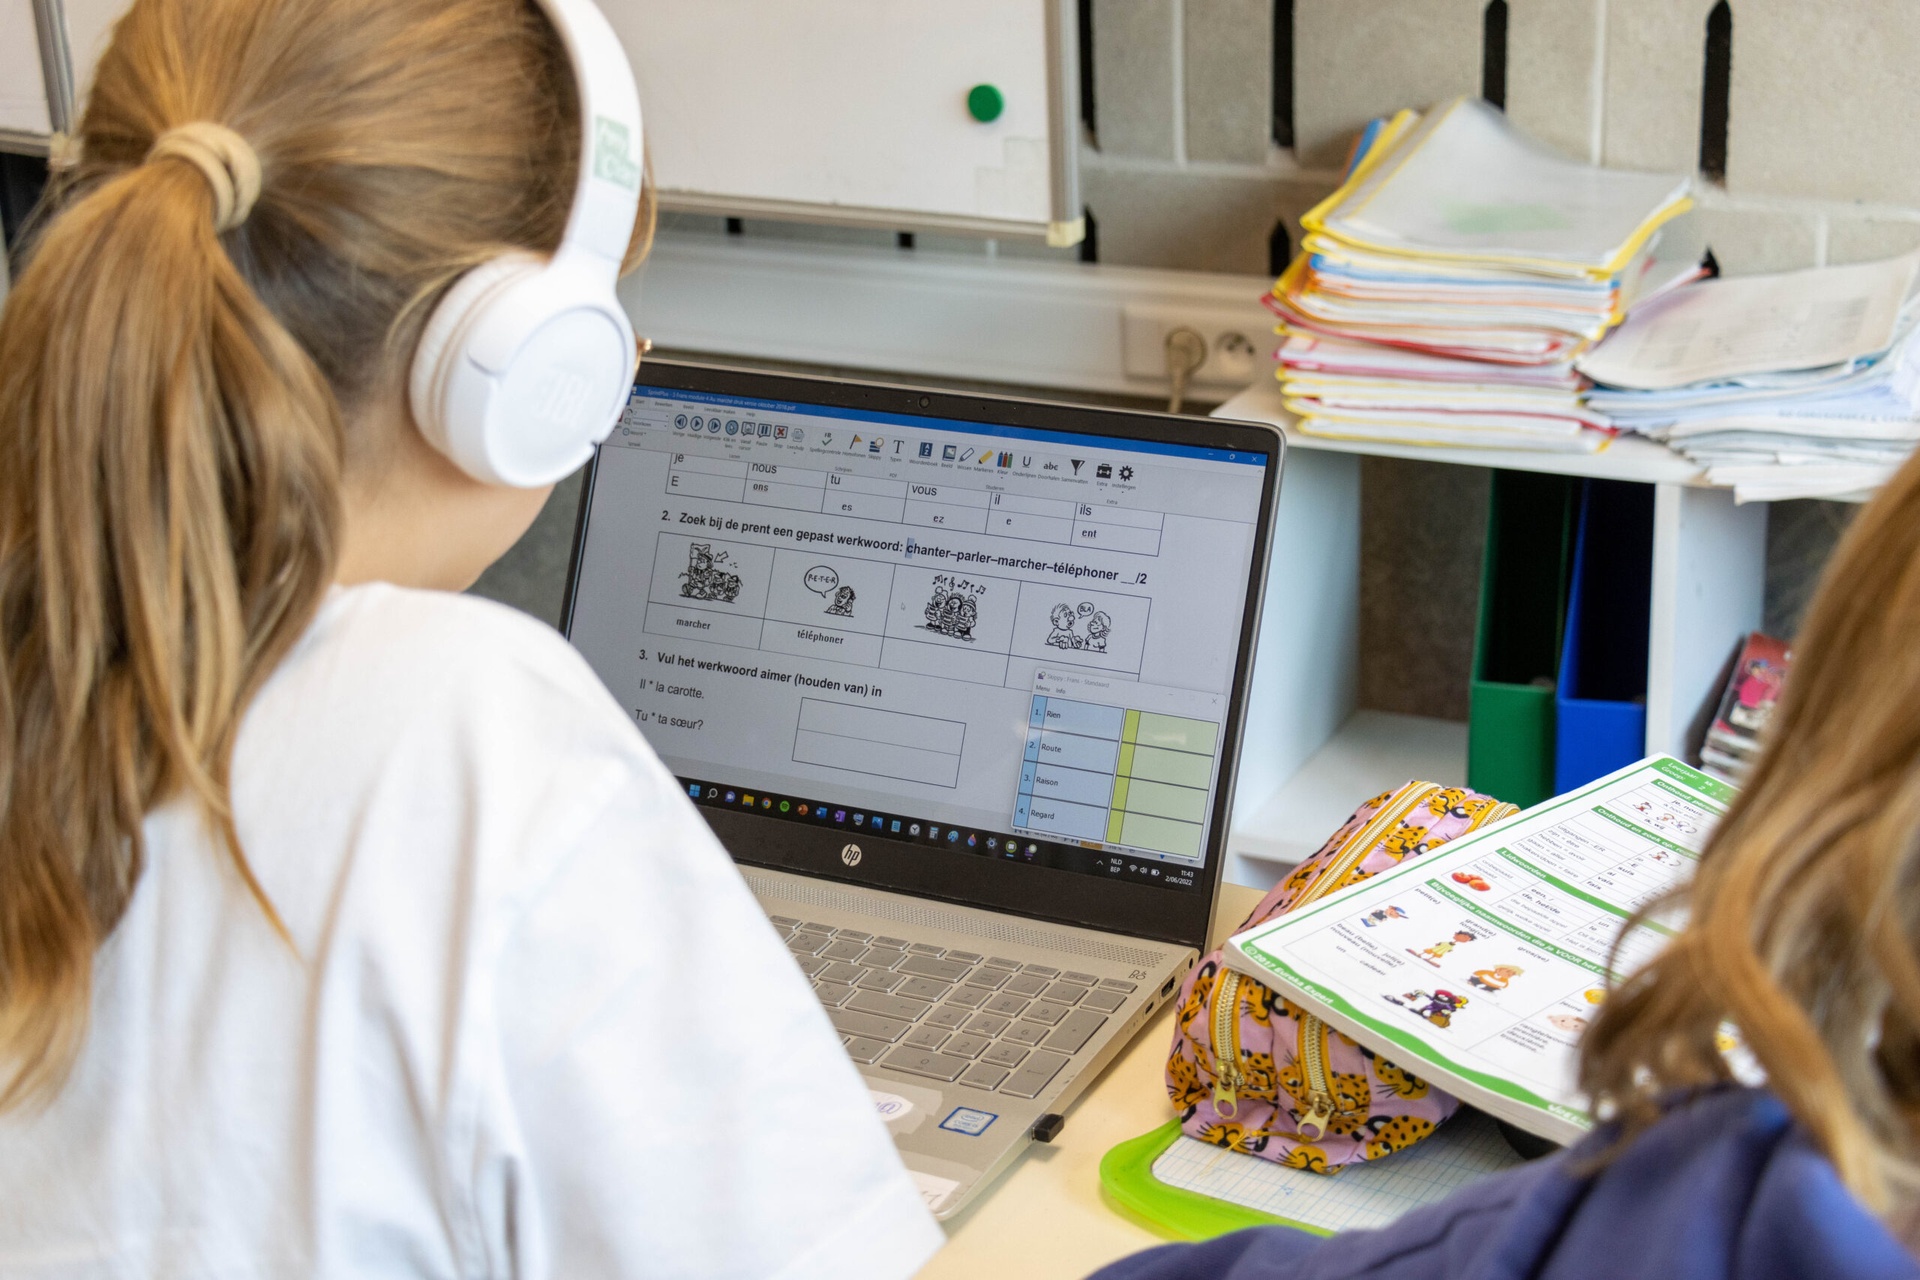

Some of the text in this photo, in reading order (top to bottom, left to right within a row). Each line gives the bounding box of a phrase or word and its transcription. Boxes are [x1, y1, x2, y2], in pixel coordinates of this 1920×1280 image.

[752, 464, 778, 474] nous
[671, 476, 680, 486] E
[830, 475, 841, 486] tu
[752, 483, 768, 492] ons
[912, 486, 937, 496] vous
[994, 495, 1001, 505] il
[842, 503, 852, 512] es
[1079, 504, 1092, 516] ils
[933, 514, 945, 524] ez
[1006, 517, 1012, 526] e
[661, 510, 670, 521] 2.
[679, 512, 706, 526] Zoek
[709, 516, 722, 530] bij
[725, 518, 739, 530] de
[741, 521, 771, 535] prent
[773, 526, 794, 538] een
[796, 529, 834, 544] gepast
[836, 533, 904, 553] werkwoord:
[1082, 528, 1097, 539] ent
[676, 617, 712, 631] marcher
[796, 629, 844, 646] téléphoner
[638, 649, 883, 698] 3. Vul het werkwoord aimer (houden van) in
[655, 682, 665, 693] la
[667, 684, 705, 700] carotte.
[634, 709, 704, 731] Tu ta sœur?
[1034, 708, 1062, 720] 1. Rien
[1029, 742, 1062, 754] 2. Route
[1662, 766, 1686, 781] Groep:
[1024, 774, 1059, 787] 3. Raison
[1657, 781, 1692, 802] Onthoud:
[1018, 808, 1055, 820] 4. Regard
[1597, 808, 1632, 831] Onthoud
[842, 844, 862, 866] hp
[1110, 858, 1122, 866] NLD
[1501, 850, 1548, 879] Lidwoorden
[1181, 870, 1194, 878] 11:43
[1164, 876, 1192, 886] 2/06/2022
[1430, 880, 1476, 911] Bijvoeglijke
[1475, 908, 1532, 940] naamwoorden
[1556, 948, 1582, 964] VOOR
[1274, 966, 1304, 987] Eureka
[1303, 984, 1334, 1006] Expert
